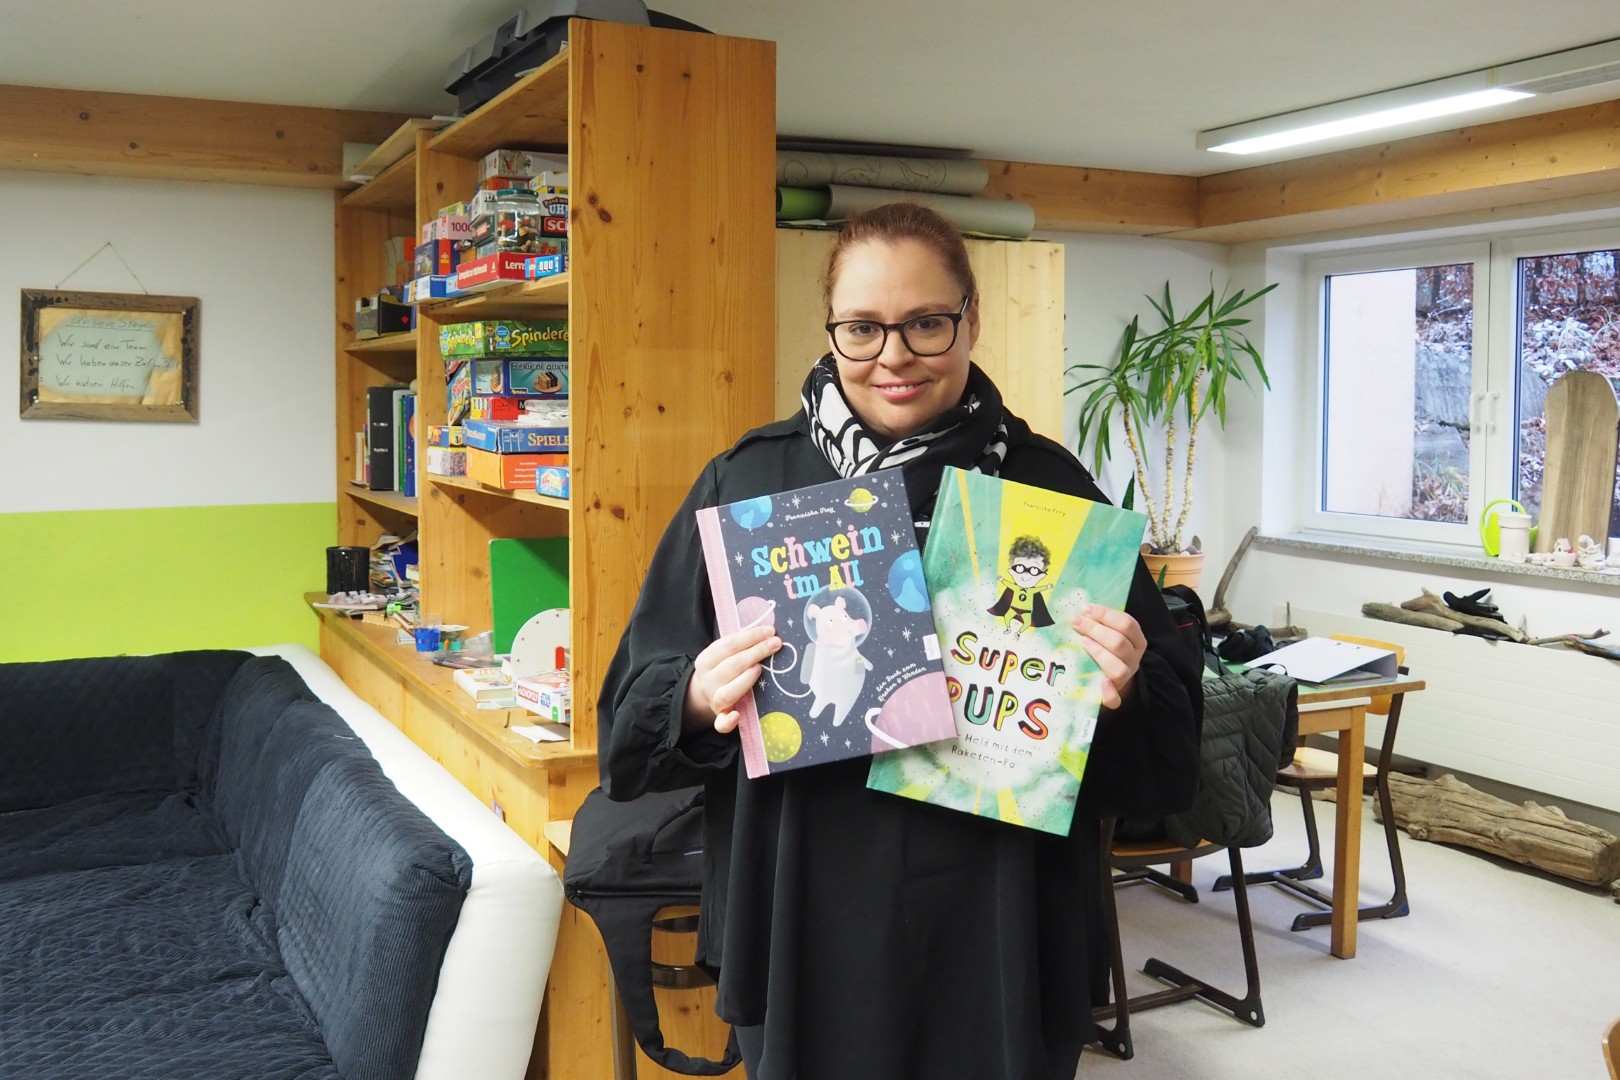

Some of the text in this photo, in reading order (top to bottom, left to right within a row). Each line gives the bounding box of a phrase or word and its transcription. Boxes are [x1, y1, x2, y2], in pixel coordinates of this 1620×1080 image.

[57, 332, 74, 347] Wir
[119, 339, 146, 350] Team
[56, 353, 72, 366] Wir
[80, 355, 106, 367] haben
[55, 375, 71, 387] Wir
[751, 524, 884, 577] Schwein
[783, 560, 864, 599] im All
[951, 631, 1066, 686] Super
[876, 663, 917, 692] Ein Buch zum
[878, 683, 897, 702] Drehen
[902, 667, 927, 680] Wenden
[951, 745, 1016, 769] Raketen-Po
[964, 734, 1033, 757] Held mit dem
